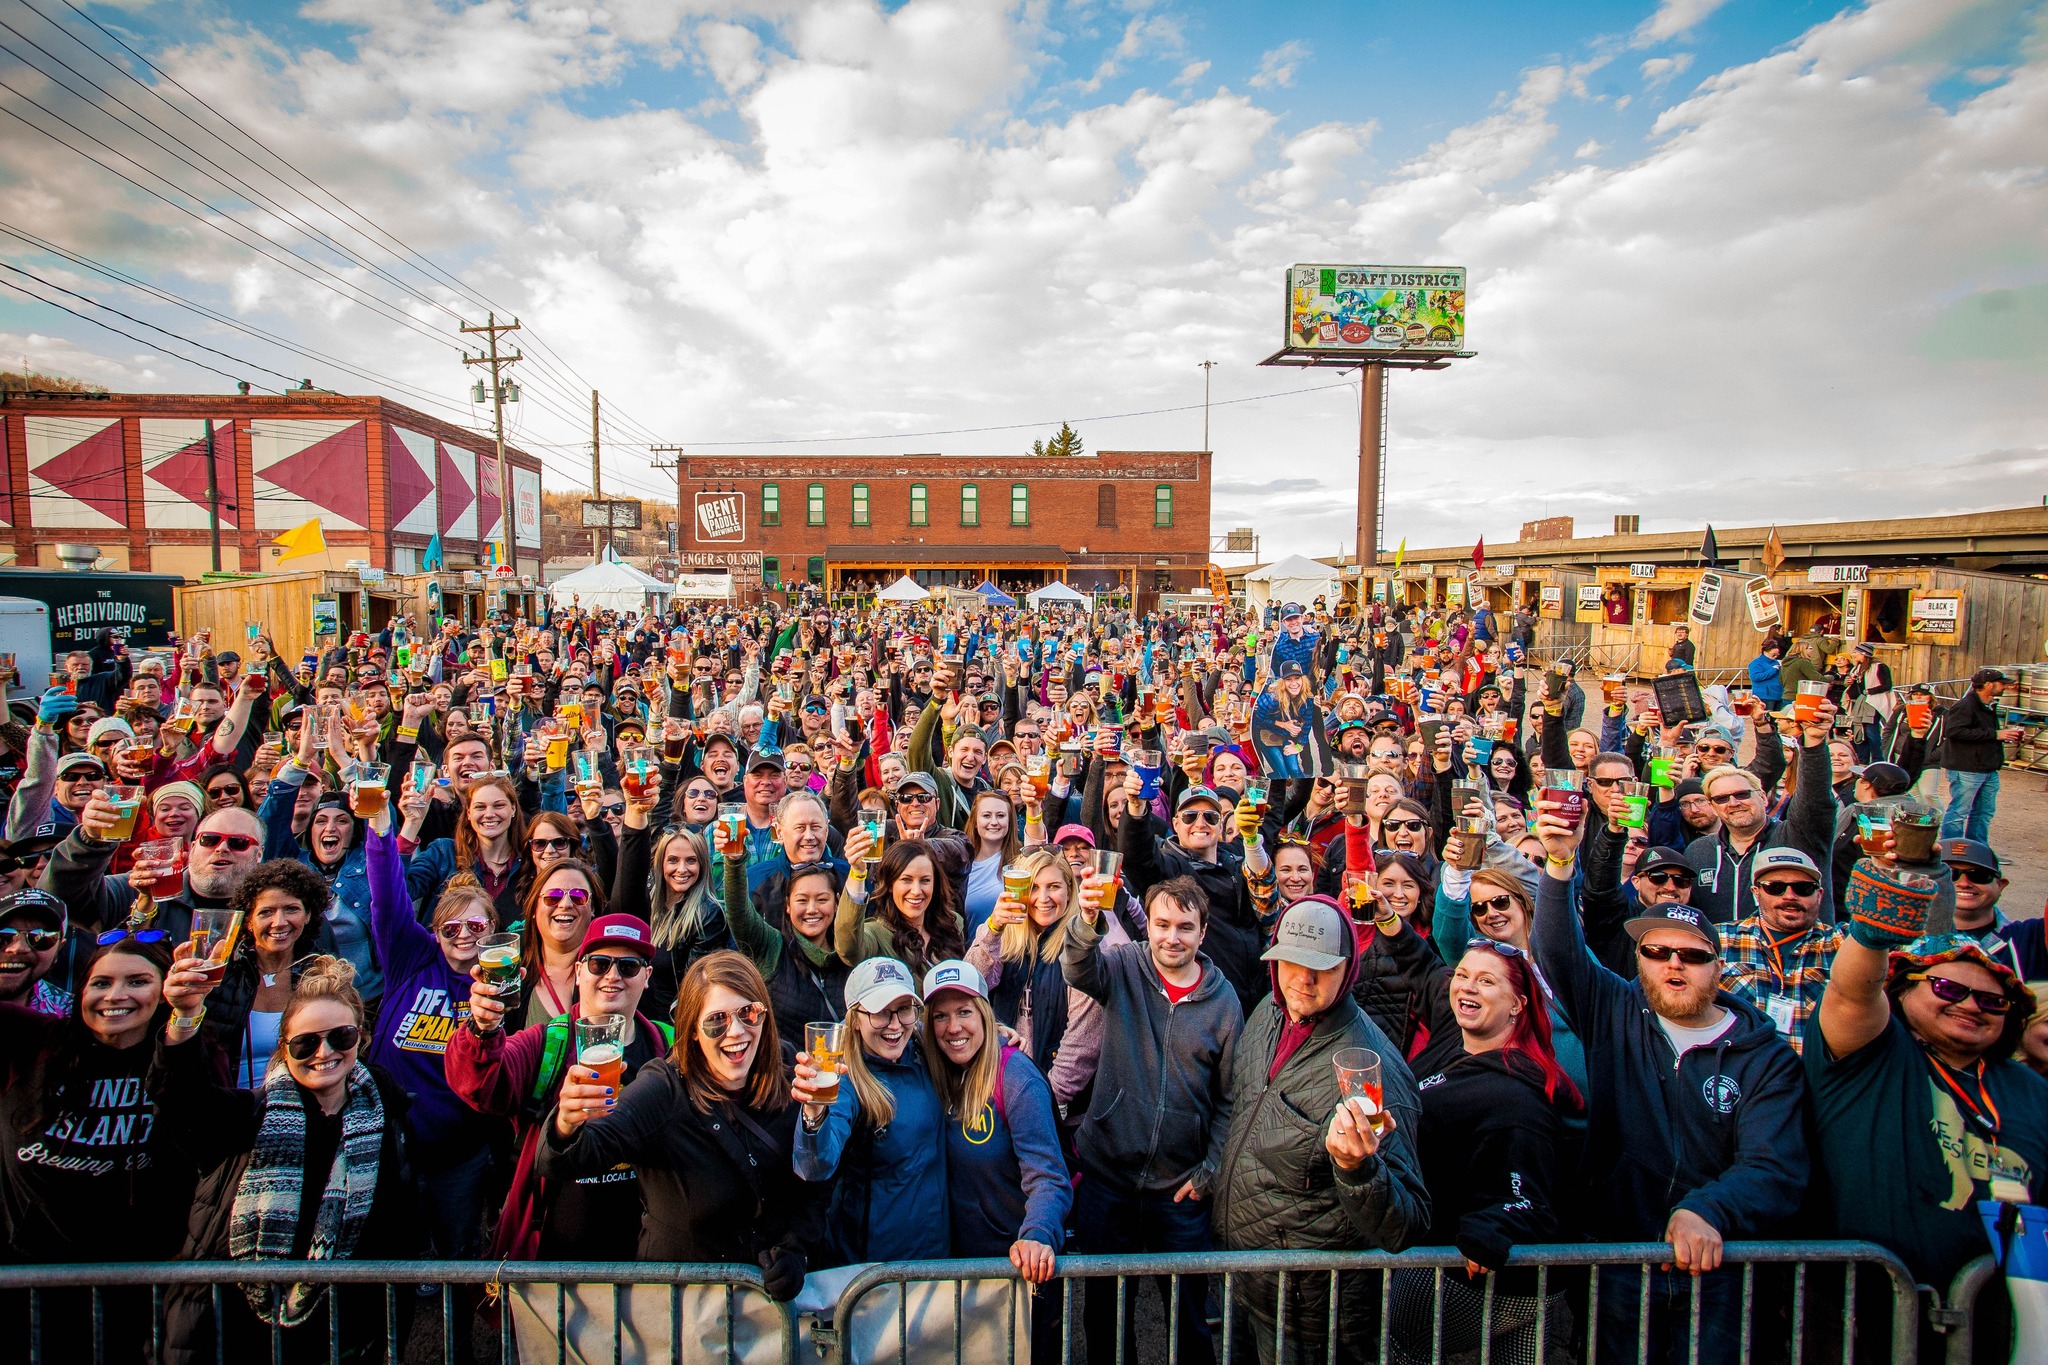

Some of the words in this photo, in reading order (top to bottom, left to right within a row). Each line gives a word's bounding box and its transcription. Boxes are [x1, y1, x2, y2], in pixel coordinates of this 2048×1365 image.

[1337, 273, 1387, 286] CRAFT
[1390, 274, 1460, 287] DISTRICT
[705, 496, 736, 520] BENT
[708, 513, 739, 532] PADDLE
[711, 526, 735, 538] BREWING
[682, 553, 714, 566] ENGER
[1631, 565, 1654, 577] BLACK
[1833, 566, 1866, 581] BLACK
[97, 590, 112, 598] THE
[1695, 586, 1708, 610] BLACK
[1928, 602, 1947, 610] BLACK
[56, 601, 147, 628] HERBIVOROUS
[1285, 921, 1325, 936] PRYES
[410, 987, 455, 1018] NFL
[17, 1142, 115, 1177] Brewing
[601, 1172, 629, 1184] LOCAL
